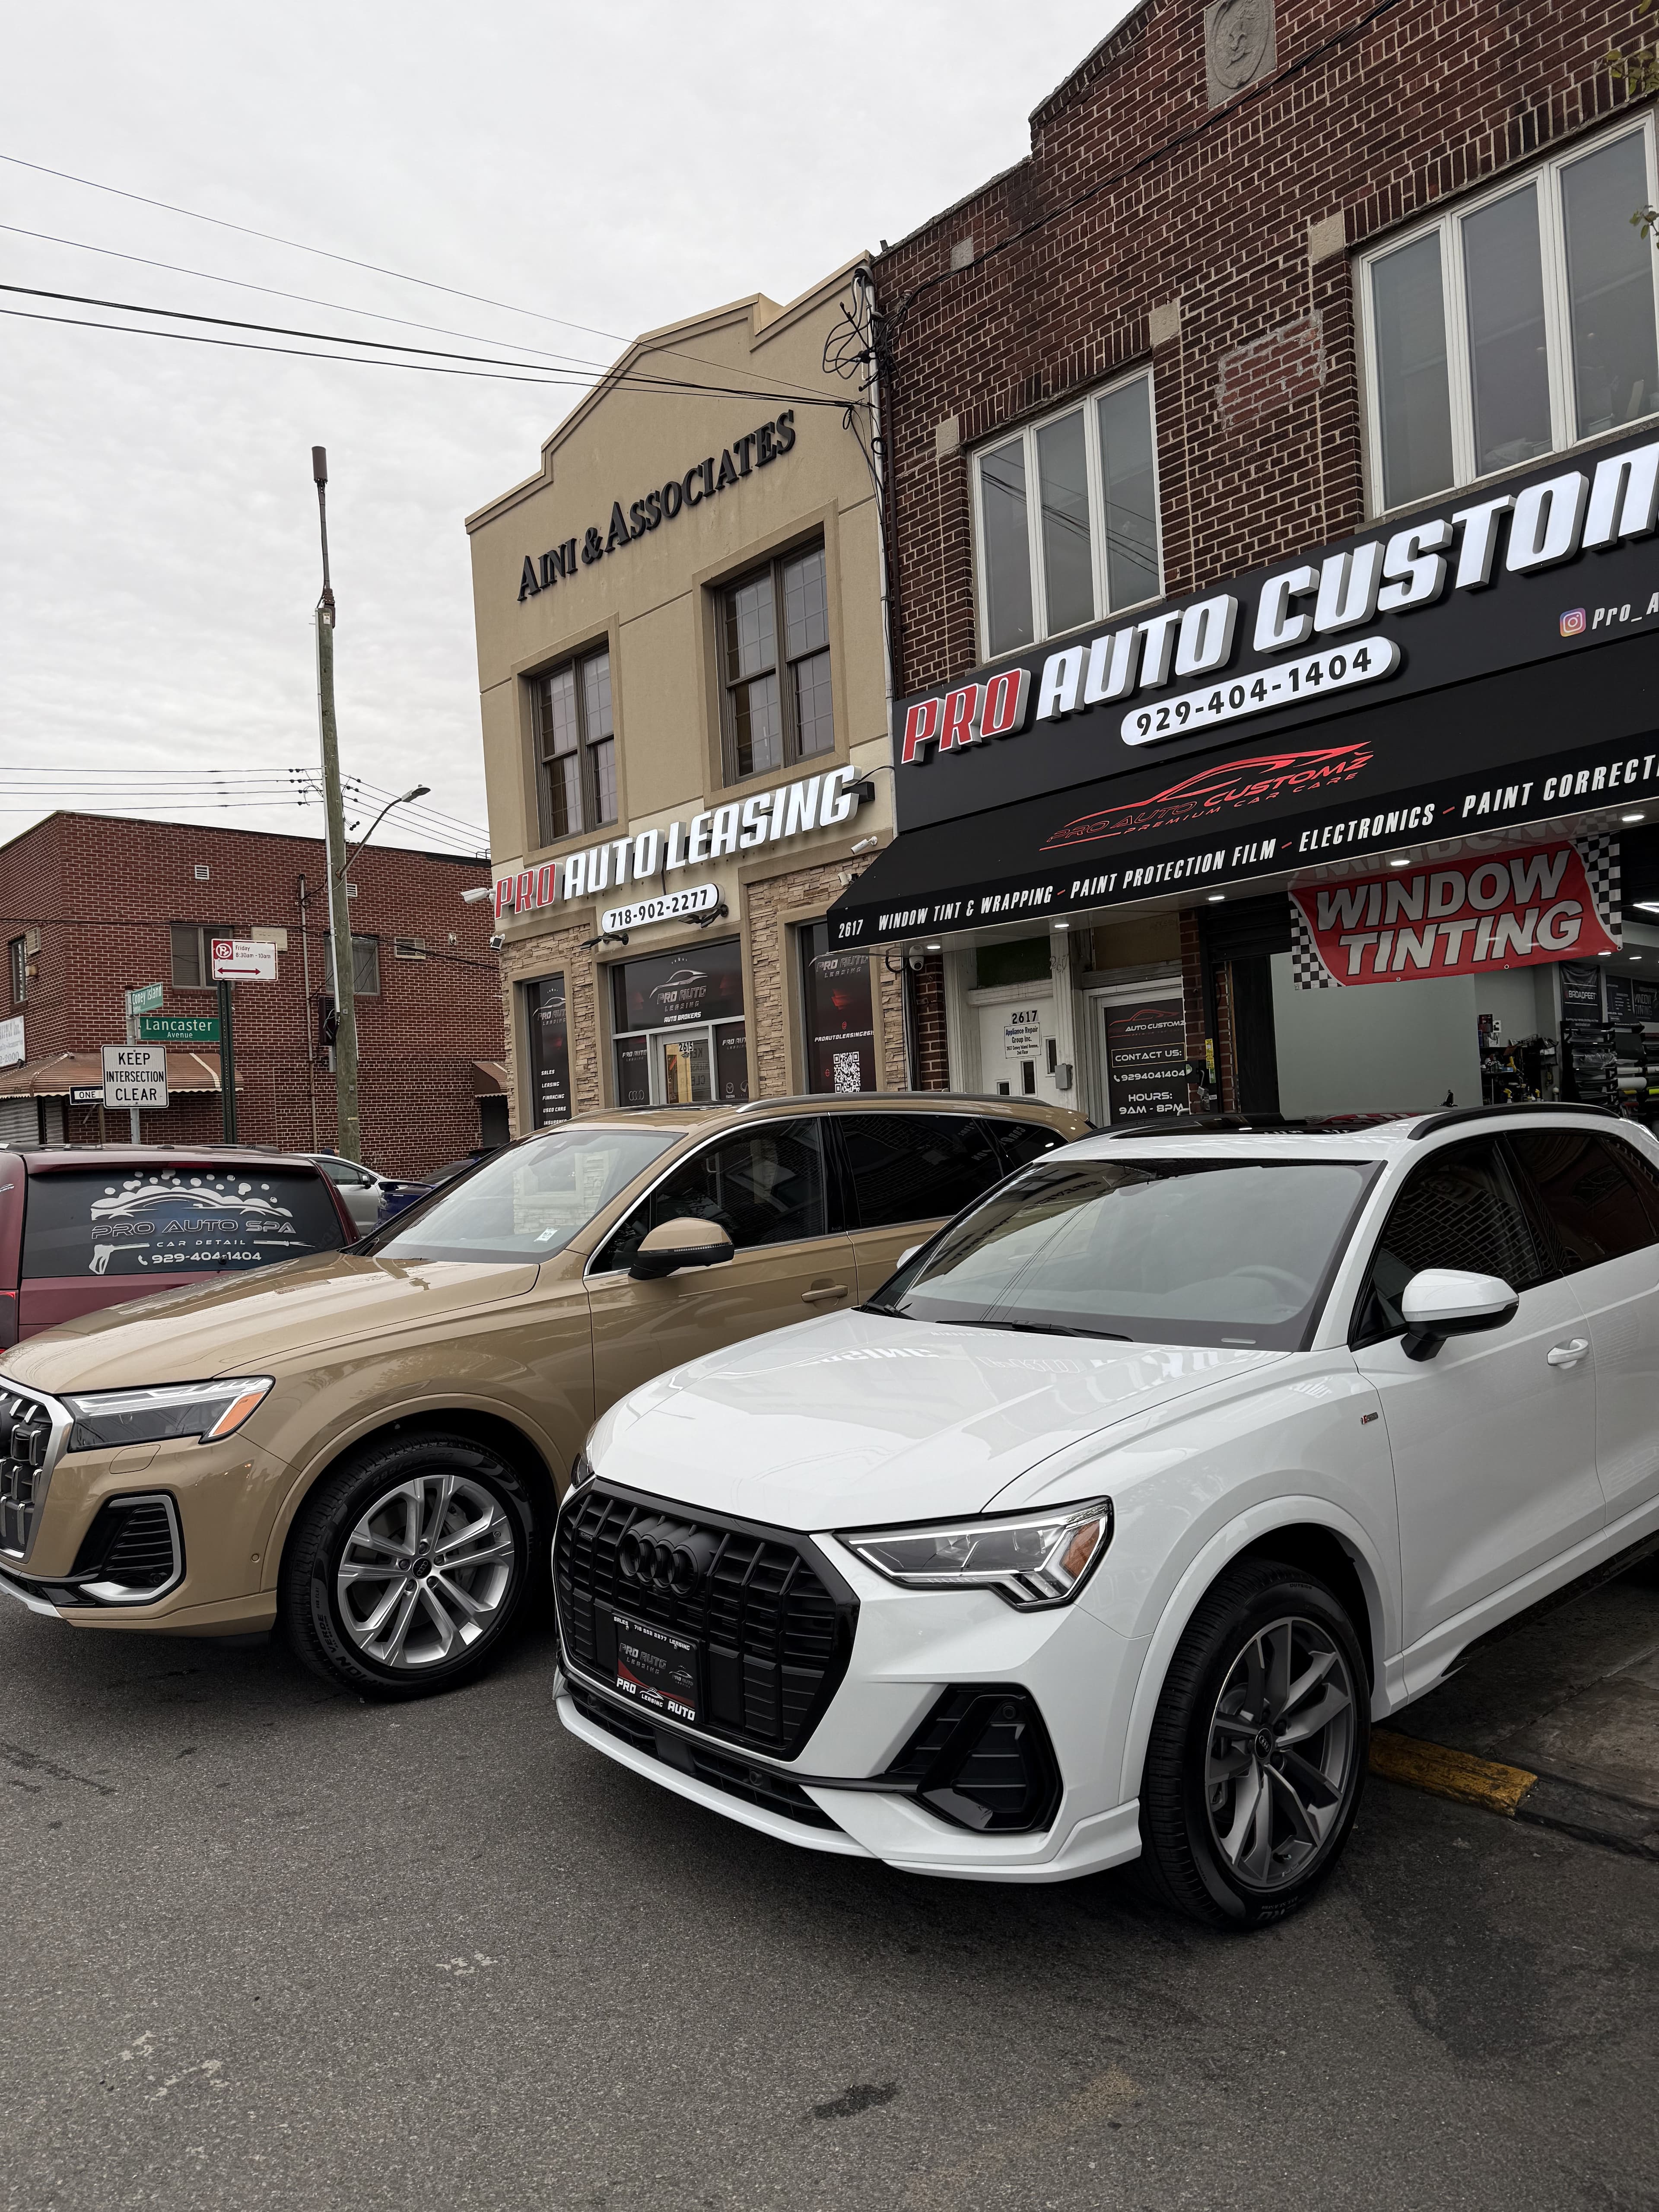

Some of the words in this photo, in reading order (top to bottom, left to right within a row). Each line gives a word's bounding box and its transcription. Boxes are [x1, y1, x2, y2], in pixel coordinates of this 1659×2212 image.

[517, 537, 578, 601] AINI
[581, 527, 603, 565] &
[605, 409, 796, 553] ASSOCIATES
[901, 667, 1031, 765] PRO
[1036, 594, 1238, 722] AUTO
[1137, 647, 1372, 737] 929-404-1404
[1124, 807, 1221, 835] PREMIUM
[1233, 792, 1280, 807] CAR
[1293, 773, 1357, 794] CARE
[1046, 821, 1109, 842] PRO
[1110, 801, 1197, 829] AUTO
[496, 862, 562, 919] PRO
[564, 829, 665, 900] AUTO
[666, 765, 862, 870] LEASING
[838, 918, 864, 938] 2617
[879, 908, 929, 932] WINDOW
[934, 903, 960, 922] TINT
[966, 900, 975, 916] &
[980, 886, 1053, 914] WRAPPING
[1070, 873, 1118, 899] PAINT
[1122, 849, 1225, 889] PROTECTION
[1232, 838, 1277, 867] FILM
[1298, 803, 1436, 853] ELECTRONICS
[1462, 782, 1534, 818] PAINT
[1542, 754, 1659, 802] CORRECT
[1316, 850, 1572, 932] WINDOW
[610, 889, 709, 928] 718-902-2277
[1339, 900, 1583, 977] TINTING
[816, 958, 838, 973] PRO
[839, 954, 869, 968] AUTO
[824, 966, 861, 979] LEASING
[132, 992, 146, 1005] Coney
[147, 985, 162, 1001] Island
[657, 991, 678, 1004] PRO
[679, 985, 707, 1001] AUTO
[1568, 990, 1597, 1000] BROADFEET
[537, 1011, 551, 1021] PRO
[664, 1001, 700, 1012] LEASING
[677, 1011, 702, 1021] BROKERS
[146, 1018, 212, 1032] Lancaster
[1012, 1010, 1037, 1024] 2617
[1006, 1028, 1024, 1036] Appliance
[1025, 1026, 1038, 1034] Repair
[679, 1042, 693, 1052] 2615
[1115, 1051, 1162, 1062] CONTACT
[1164, 1049, 1182, 1058] US:
[118, 1052, 150, 1065] KEEP
[106, 1071, 164, 1082] INTERSECTION
[1121, 1069, 1185, 1082] 9294041404
[79, 1091, 96, 1099] ONE
[115, 1088, 157, 1101] CLEAR
[1128, 1091, 1173, 1102] HOURS:
[1119, 1104, 1146, 1115] 9AM
[1156, 1103, 1184, 1113] 8PM
[92, 1221, 155, 1239] PRO
[162, 1220, 238, 1234] AUTO
[245, 1220, 296, 1234] SPA
[152, 1252, 261, 1264] 929-404-1404
[318, 1614, 337, 1653] VERDE
[613, 1616, 629, 1626] SALES
[654, 1632, 667, 1642] 2277
[669, 1638, 690, 1651] LEASING
[619, 1643, 639, 1659] PRO
[640, 1651, 667, 1669] AUTO
[626, 1656, 660, 1675] LEASING
[616, 1677, 636, 1694] PRO
[641, 1694, 664, 1708] LEASING
[667, 1700, 696, 1721] AUTO
